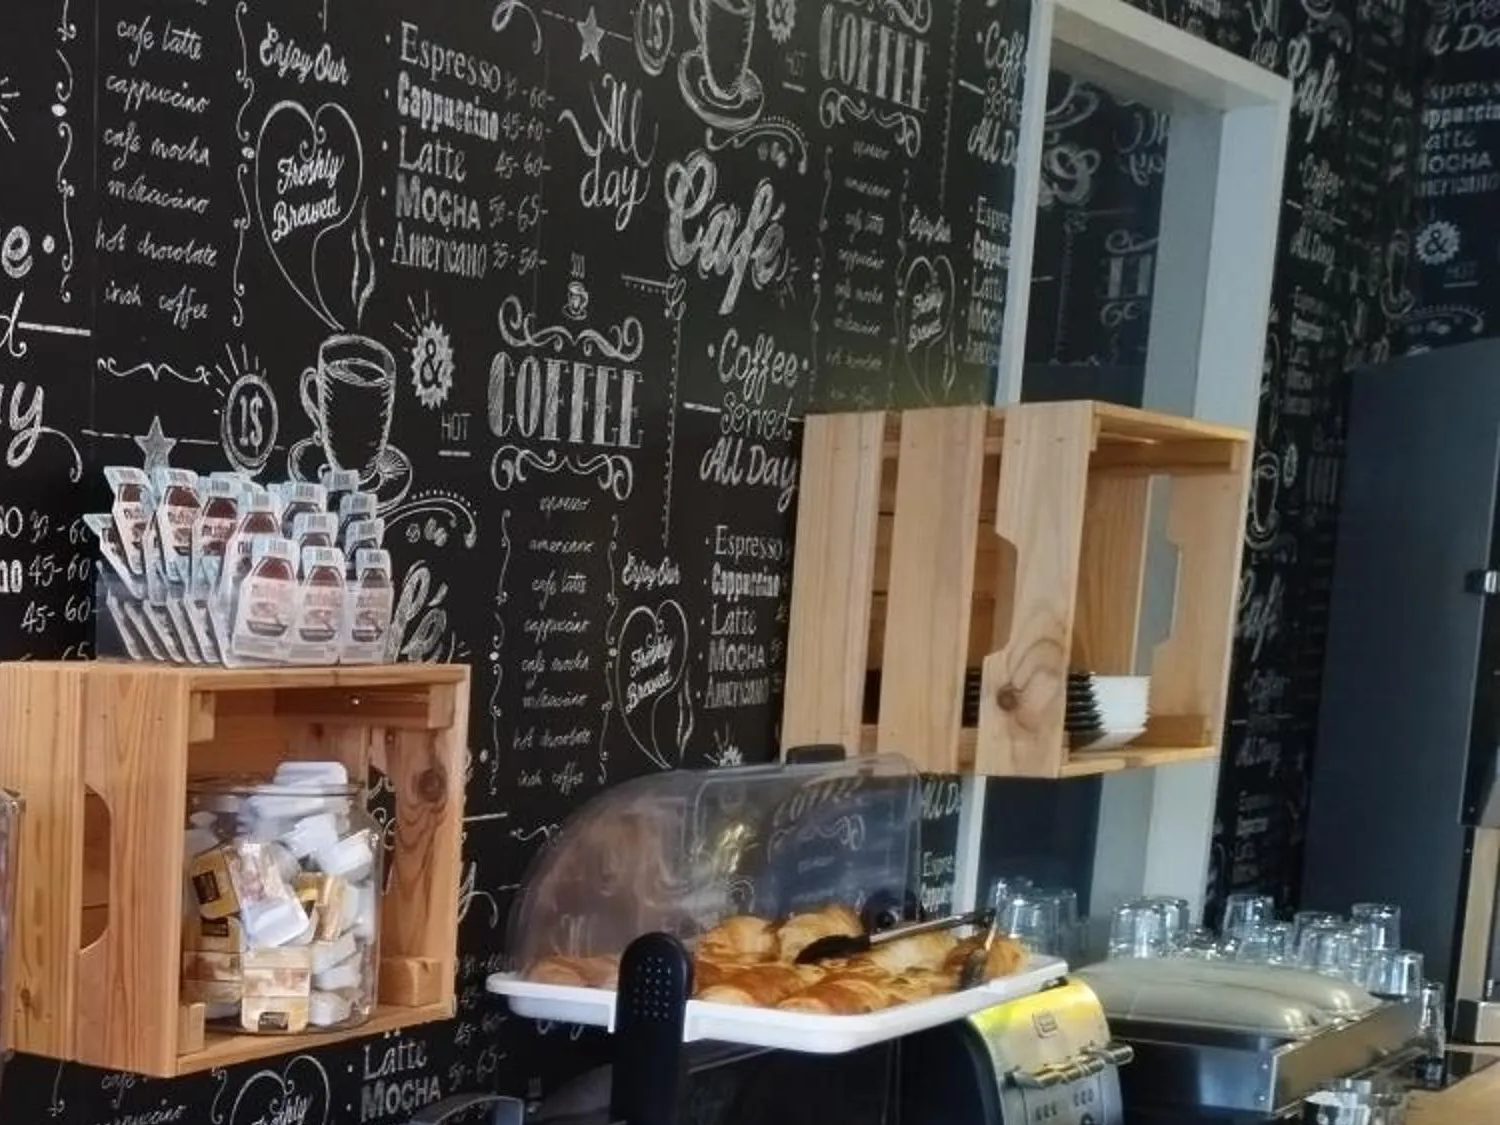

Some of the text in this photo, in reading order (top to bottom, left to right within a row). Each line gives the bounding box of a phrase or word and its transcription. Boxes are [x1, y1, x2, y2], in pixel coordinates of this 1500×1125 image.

[259, 22, 349, 86] Enjoy Our
[401, 20, 500, 93] Espresso
[398, 71, 499, 142] Cappuccino
[399, 126, 467, 183] Latte
[272, 188, 341, 243] Brewed
[665, 149, 788, 315] Café
[392, 222, 487, 279] Americano
[718, 327, 798, 405] Coffee
[440, 412, 472, 442] HOT
[488, 352, 643, 449] COFFEE
[701, 436, 797, 513] All Day
[714, 525, 783, 563] Espresso
[711, 603, 757, 635] Latte
